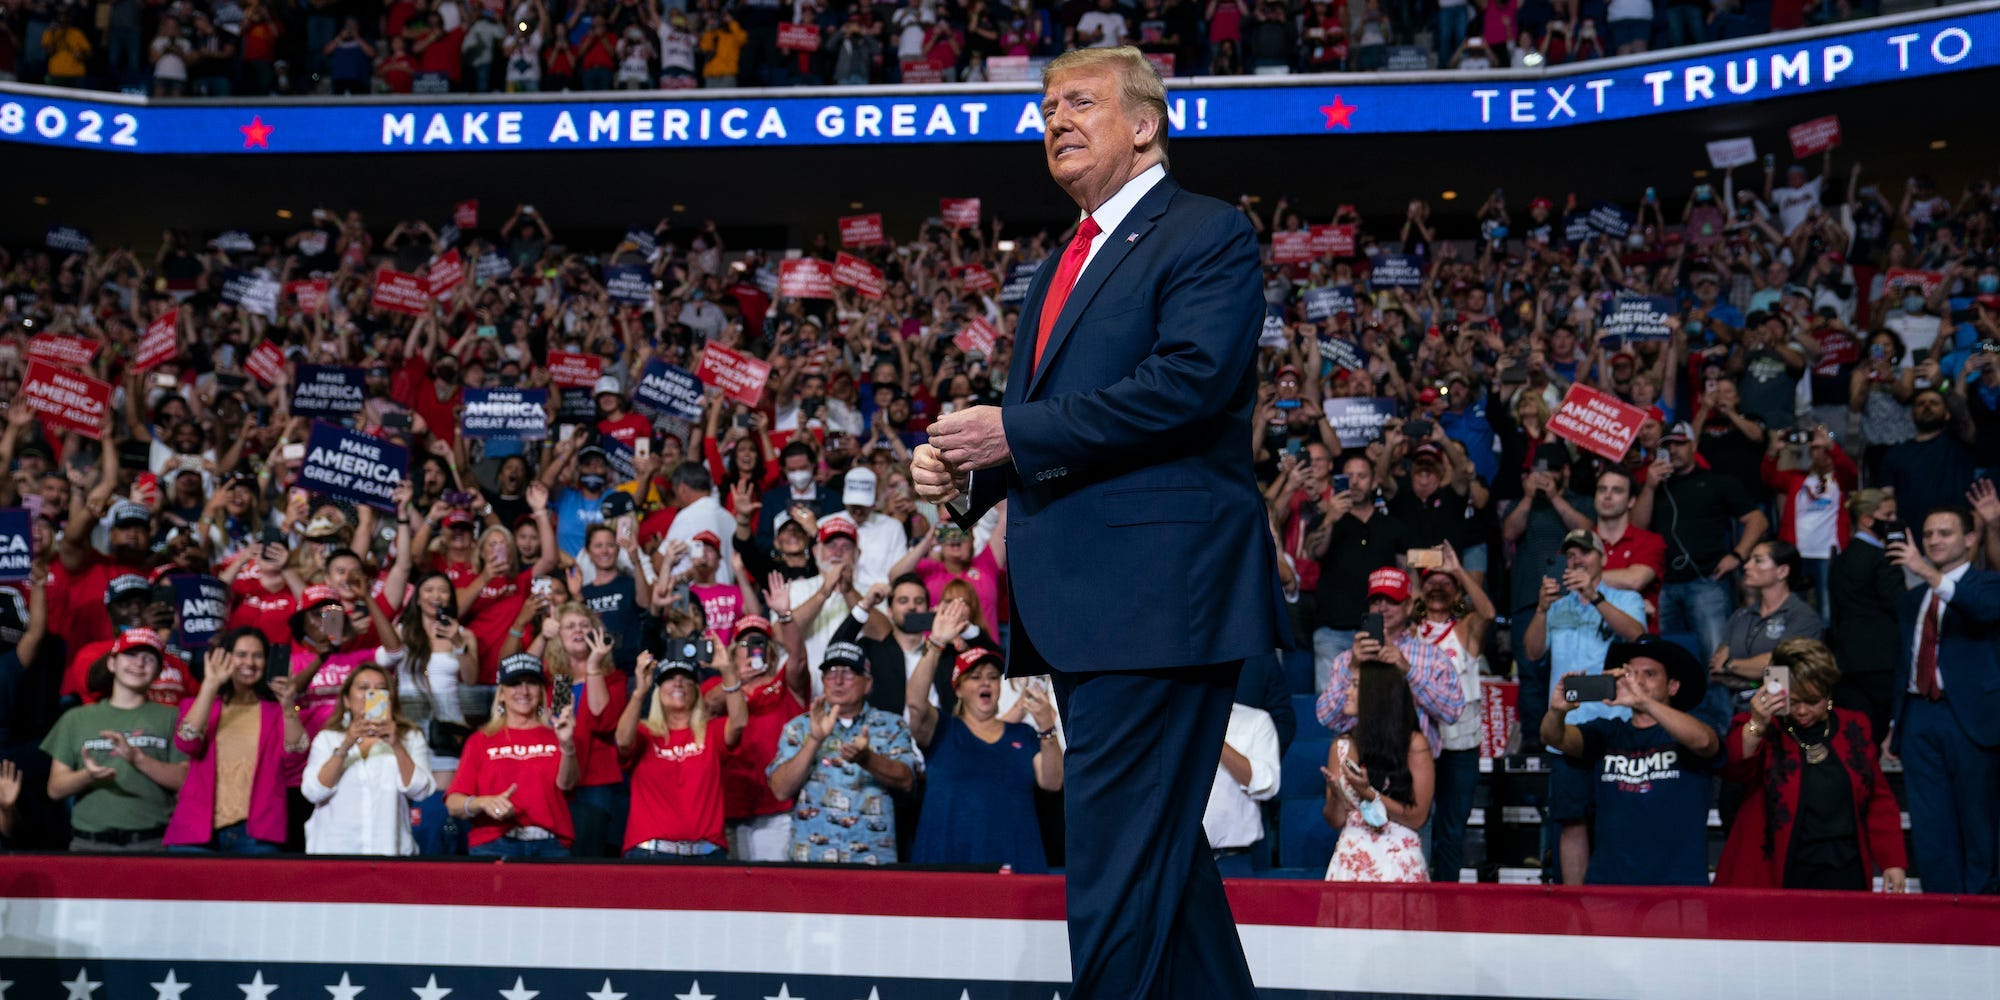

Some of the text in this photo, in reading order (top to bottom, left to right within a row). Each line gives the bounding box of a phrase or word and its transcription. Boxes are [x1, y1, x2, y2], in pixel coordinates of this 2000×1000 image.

[1473, 27, 1972, 123] TEXT TRUMP TO
[0, 102, 138, 146] 8022
[382, 97, 1208, 146] MAKE AMERICA GREAT AN!
[1372, 266, 1421, 277] AMERICA
[1621, 301, 1651, 311] MAKE
[1603, 311, 1668, 328] AMERICA
[1608, 324, 1635, 337] REAT
[53, 373, 89, 395] MAKE
[316, 372, 346, 384] MAKE
[641, 373, 698, 404] AMERIC
[25, 379, 105, 413] AMERICA
[295, 381, 363, 400] AMERICA
[488, 392, 522, 402] MAKE
[464, 401, 546, 417] AMERICA
[1588, 397, 1621, 419] MAKE
[465, 417, 545, 430] GREAT AGAIN
[1561, 401, 1631, 440] AMERICA
[1335, 427, 1363, 439] REAT
[1554, 413, 1626, 451] GREAT AGAIN
[340, 437, 382, 463] MAKE
[307, 445, 401, 485] AMERICA
[303, 465, 397, 500] GREAT AGAIN
[0, 554, 31, 569] AIN
[184, 617, 224, 633] GREA
[1488, 686, 1506, 758] AMERICA
[487, 744, 557, 758] TRUMP
[1603, 750, 1677, 777] TRUMP
